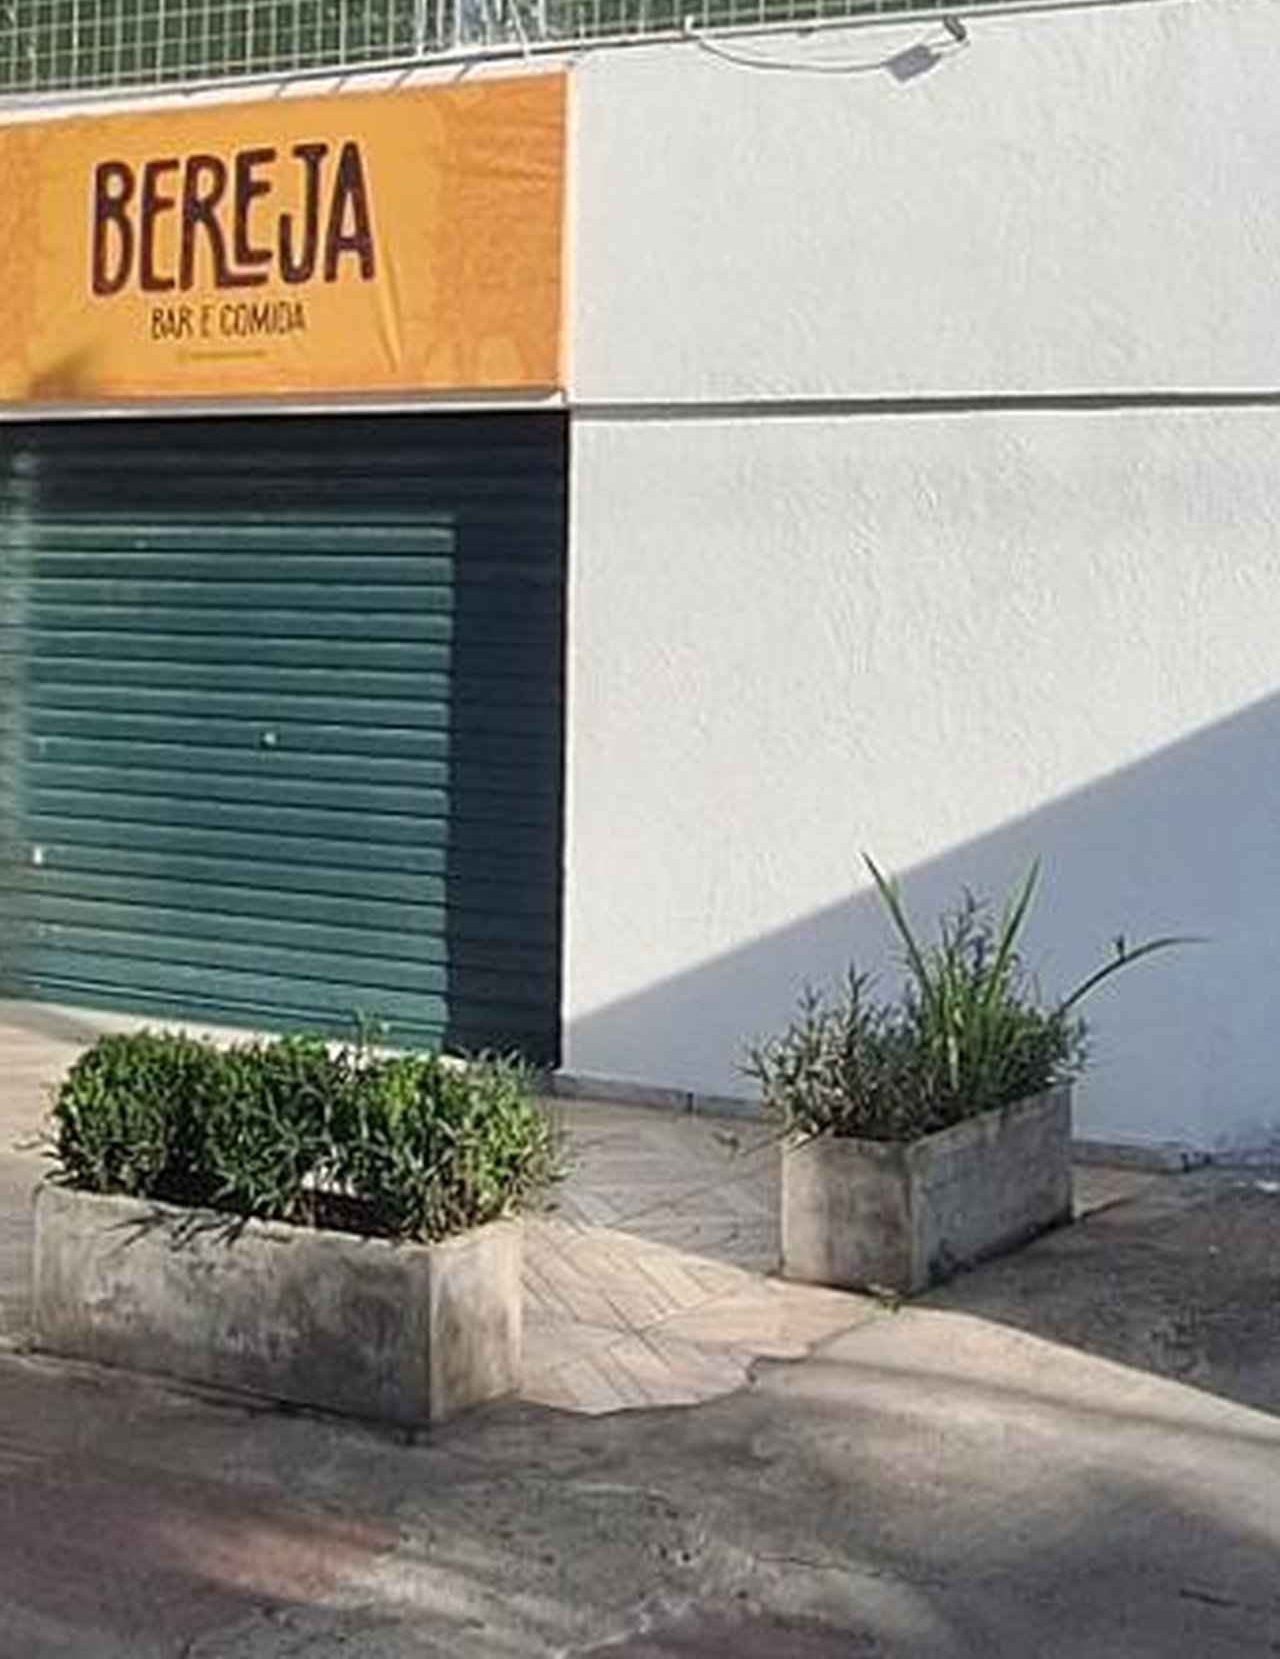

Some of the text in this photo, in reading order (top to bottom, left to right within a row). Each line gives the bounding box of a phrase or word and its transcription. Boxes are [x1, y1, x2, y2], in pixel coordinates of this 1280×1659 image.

[91, 141, 376, 297] BEREJA
[151, 300, 307, 340] BAR E COMIDA
